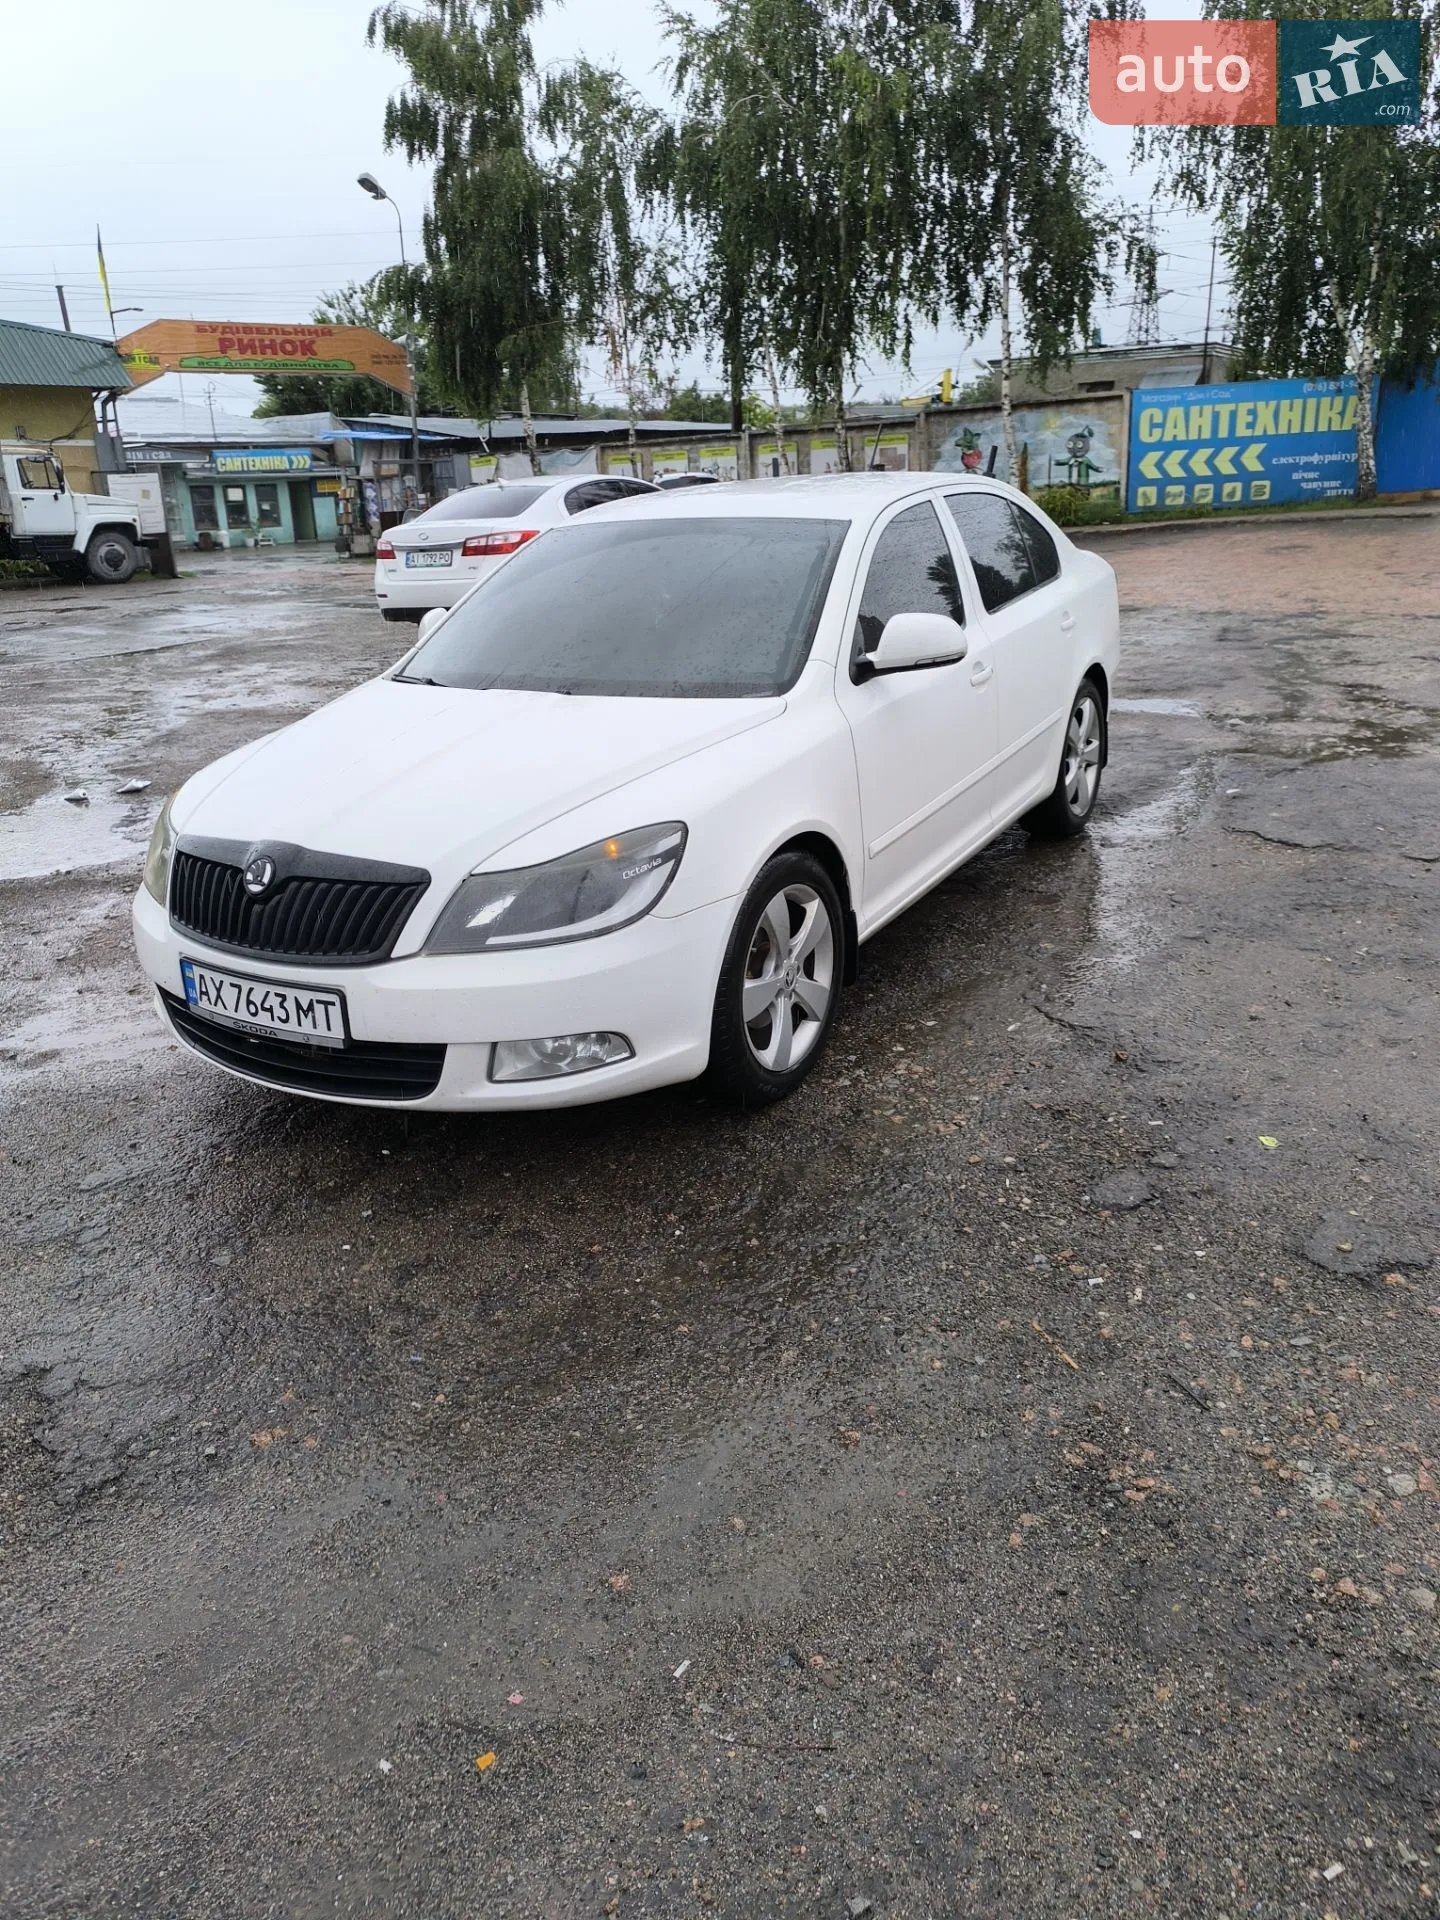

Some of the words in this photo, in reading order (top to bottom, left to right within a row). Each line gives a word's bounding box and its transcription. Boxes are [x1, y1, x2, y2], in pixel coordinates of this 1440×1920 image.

[195, 324, 333, 337] БУДІВЕЛЬНИЙ
[218, 337, 318, 356] РИНОК
[1139, 395, 1359, 443] САНТЕХНІКА
[216, 456, 290, 472] САНТЕХНІКА
[1271, 451, 1358, 465] електрофурнітур
[622, 857, 662, 879] Octavia
